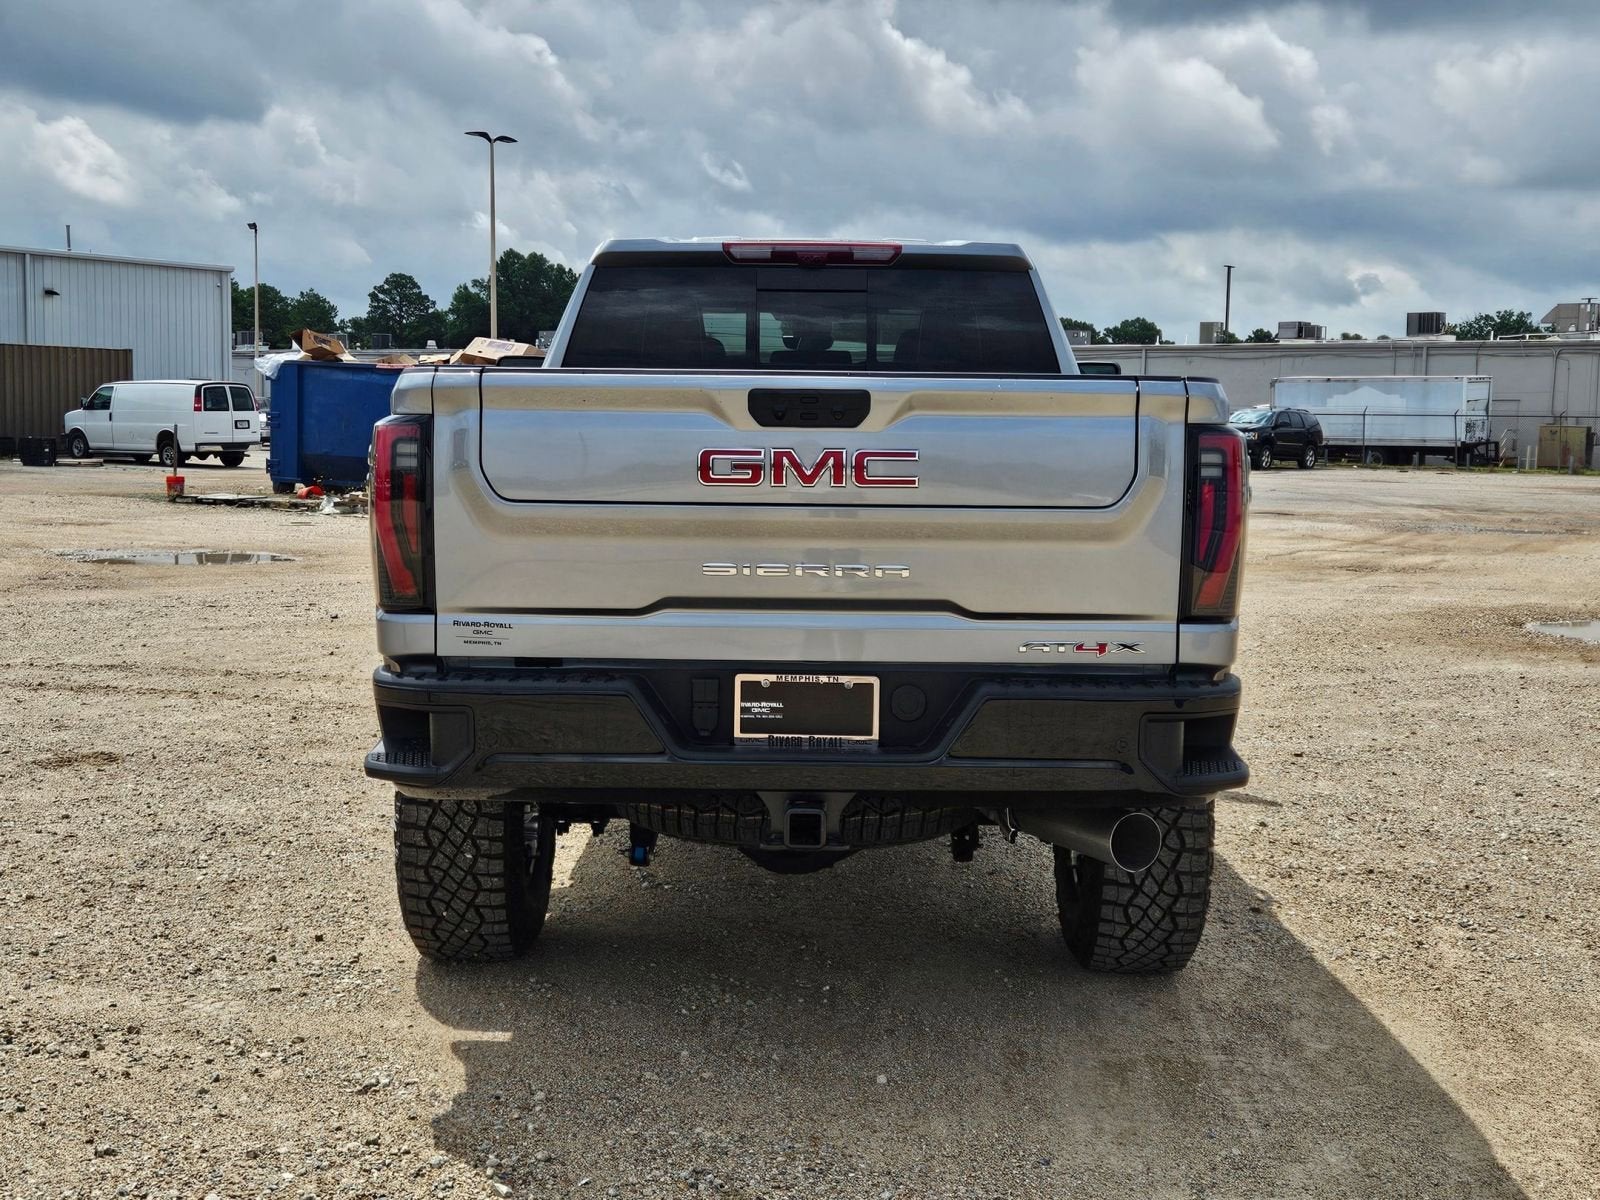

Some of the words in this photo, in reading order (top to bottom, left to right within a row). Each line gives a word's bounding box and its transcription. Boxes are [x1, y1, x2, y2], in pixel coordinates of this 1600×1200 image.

[697, 447, 919, 488] GMC
[702, 562, 911, 578] SIERRA
[453, 620, 513, 629] RIVARD-ROYALL
[1018, 641, 1146, 658] AT4X
[776, 675, 823, 684] MEMPHIS,
